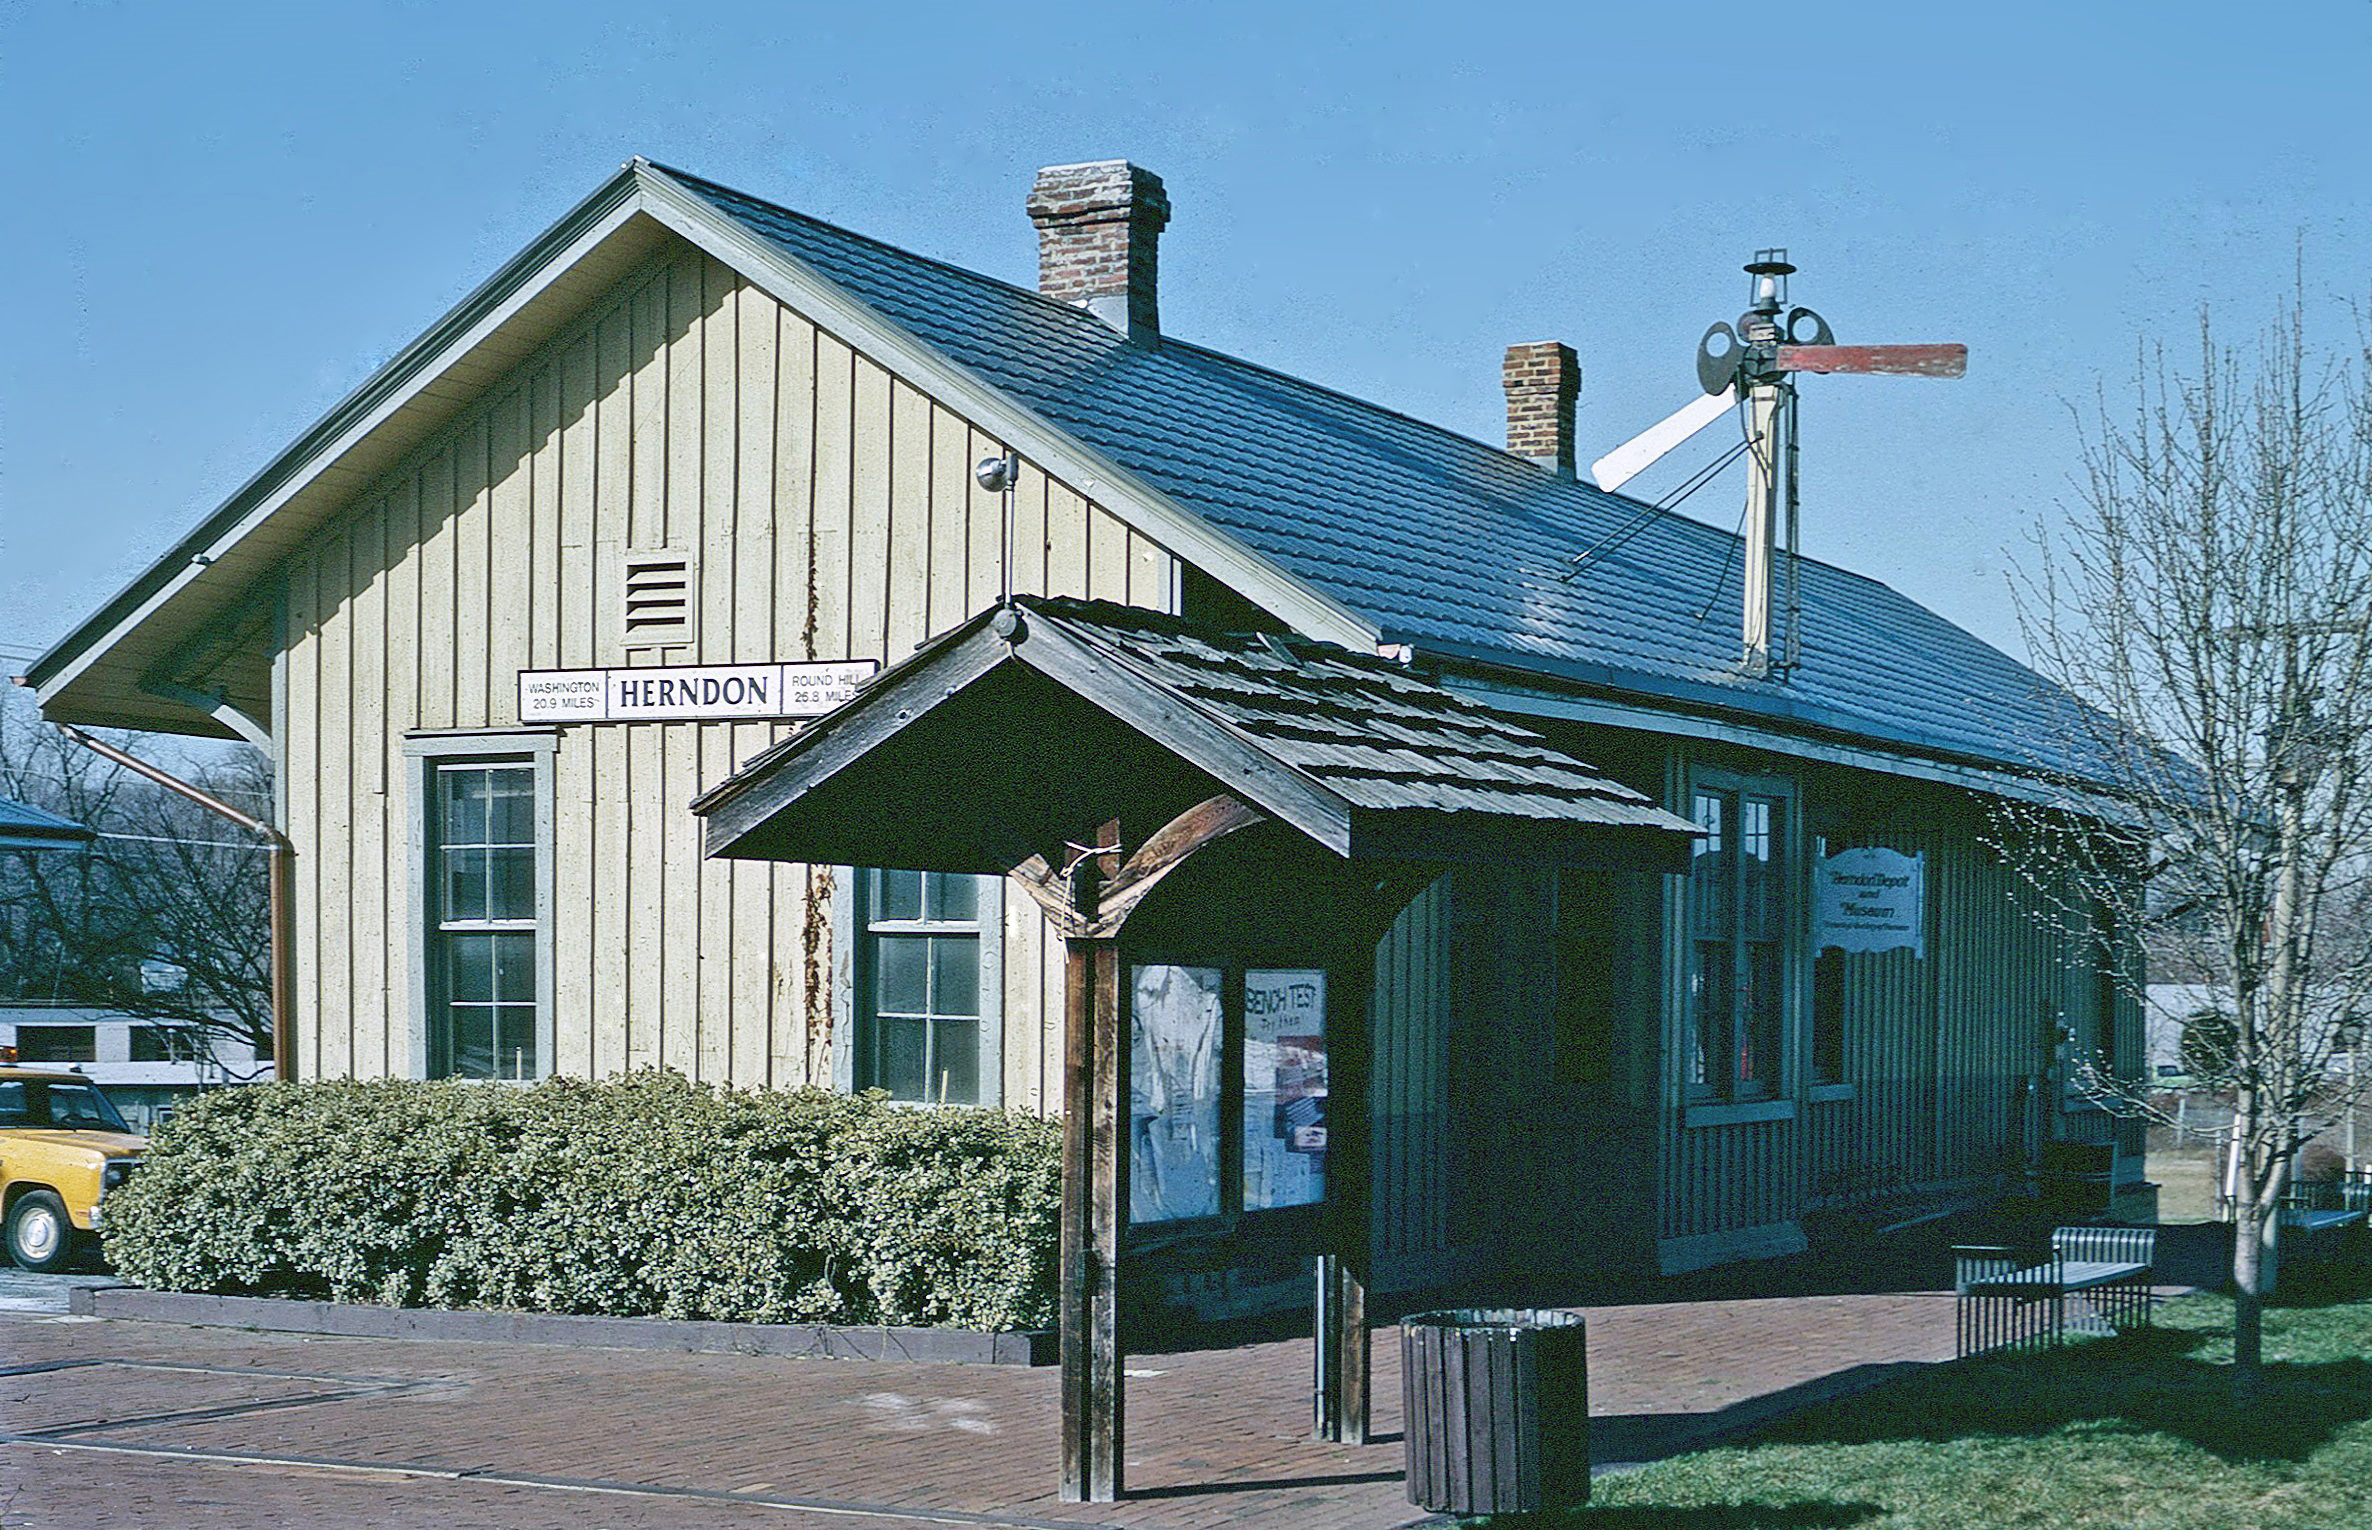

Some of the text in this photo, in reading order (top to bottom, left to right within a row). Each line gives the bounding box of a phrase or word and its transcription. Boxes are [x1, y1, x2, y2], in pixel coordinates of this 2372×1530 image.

[792, 674, 833, 687] ROUND
[528, 681, 600, 694] WASHINGTON
[620, 676, 769, 708] HERNDON
[533, 697, 595, 710] 20.9 MILES
[795, 691, 820, 703] 26.8
[1859, 889, 1881, 899] and
[1839, 902, 1895, 918] Museum
[1245, 983, 1317, 1014] BENCH TEST
